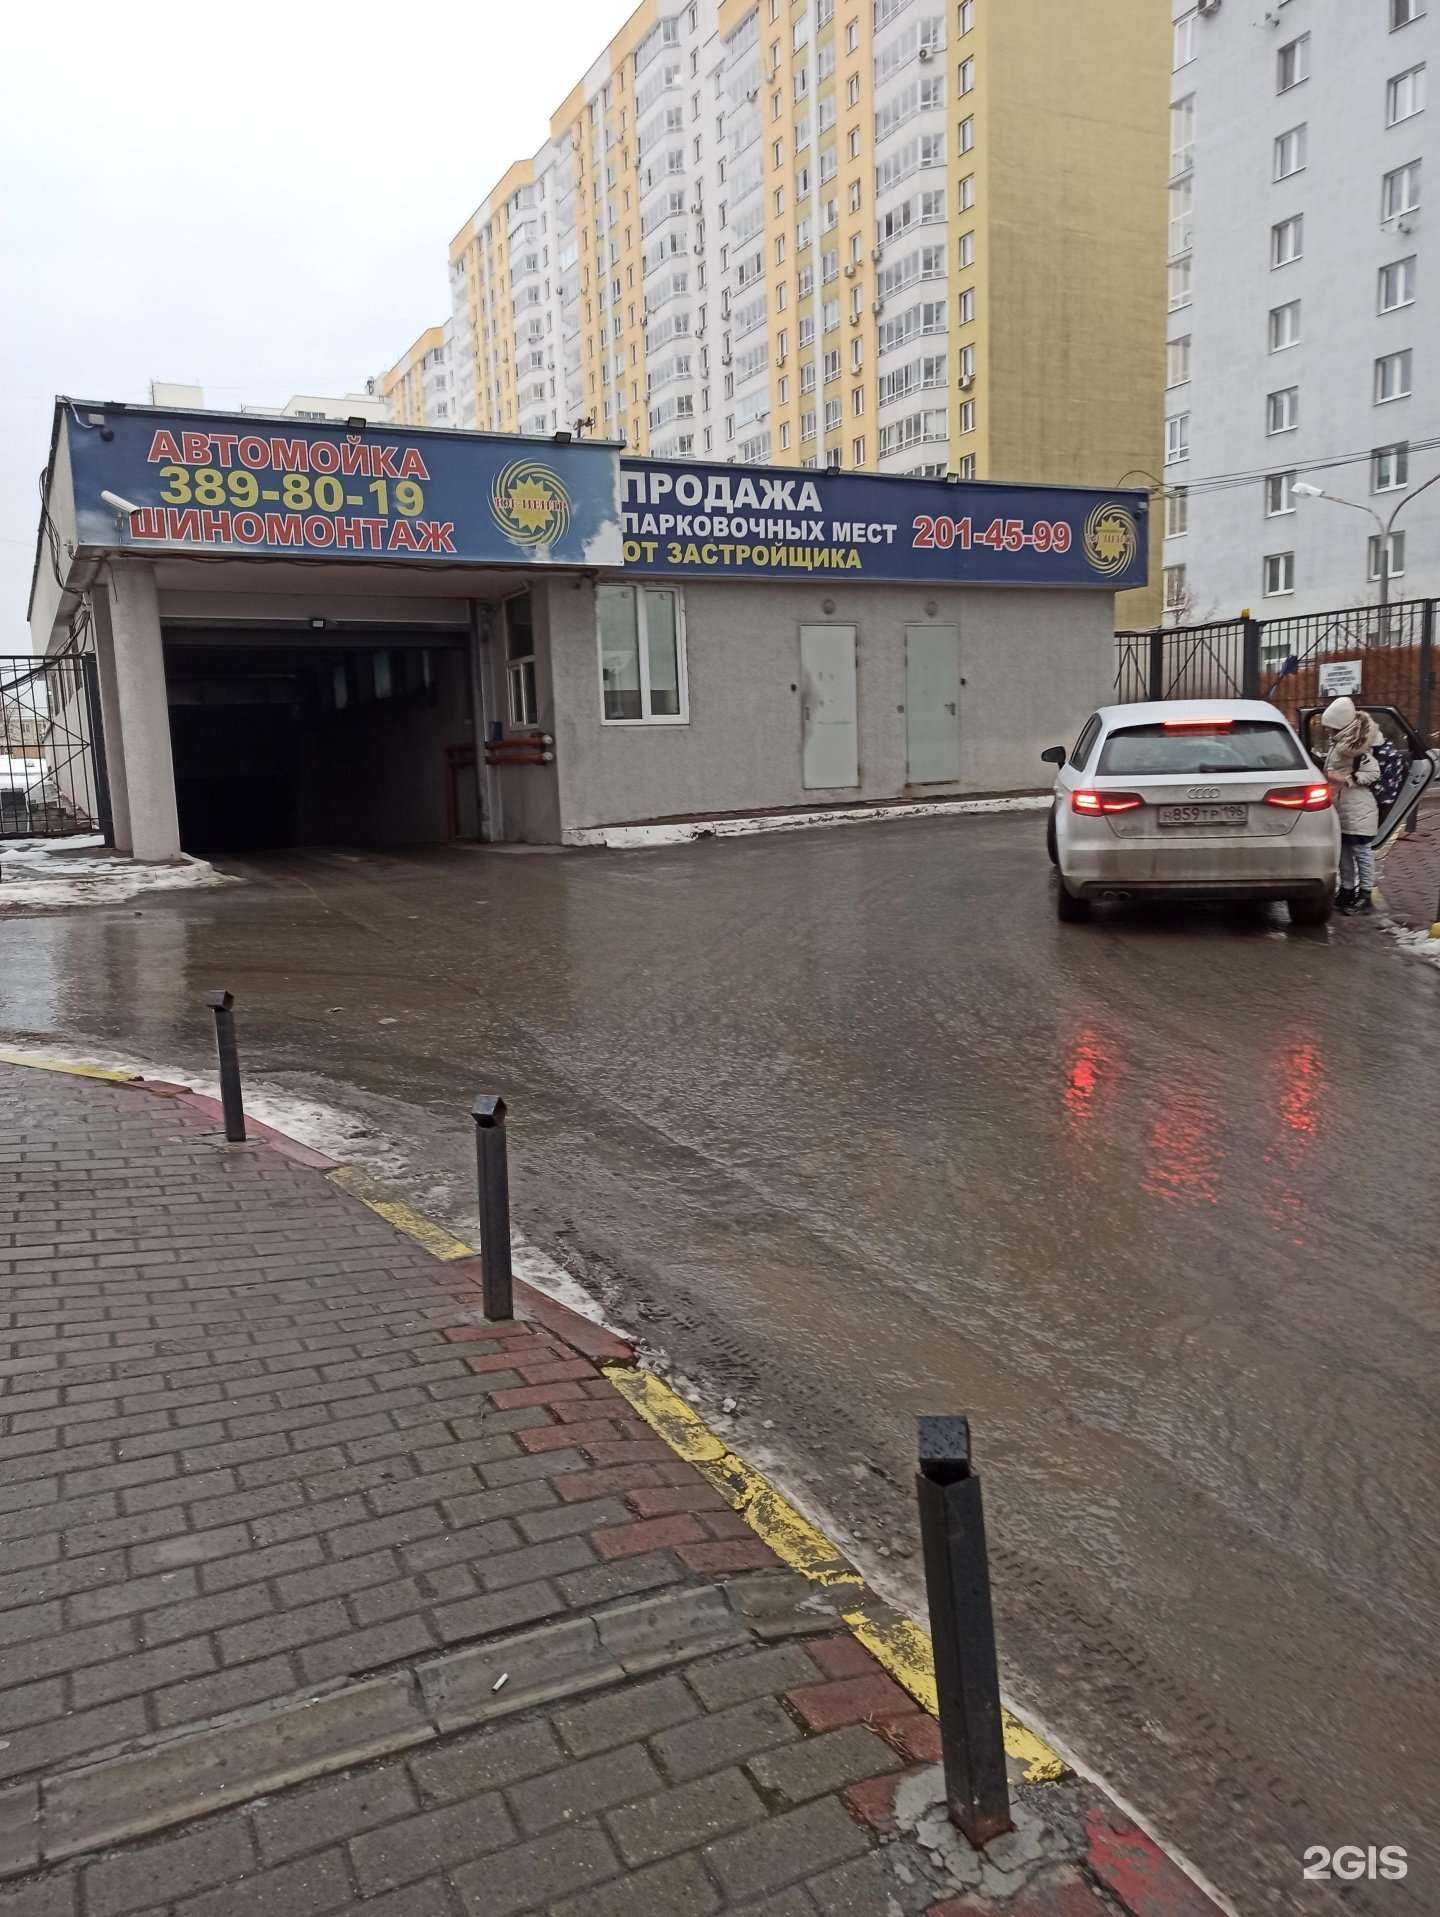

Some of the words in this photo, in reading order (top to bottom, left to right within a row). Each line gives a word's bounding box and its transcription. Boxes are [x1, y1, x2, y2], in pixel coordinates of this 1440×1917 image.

[147, 429, 431, 481] АВТОМОЙКА
[159, 465, 425, 518] 389-80-19
[620, 470, 823, 514] ПРОДАЖА
[129, 506, 458, 553] ШИНОМОНТАЖ
[621, 512, 825, 541] ПАРКОВОЧНЫХ
[832, 521, 898, 544] МЕСТ
[912, 515, 1073, 554] 201-45-99
[623, 540, 659, 563] ОТ
[666, 541, 863, 571] ЗАСТРОЙЩИКА
